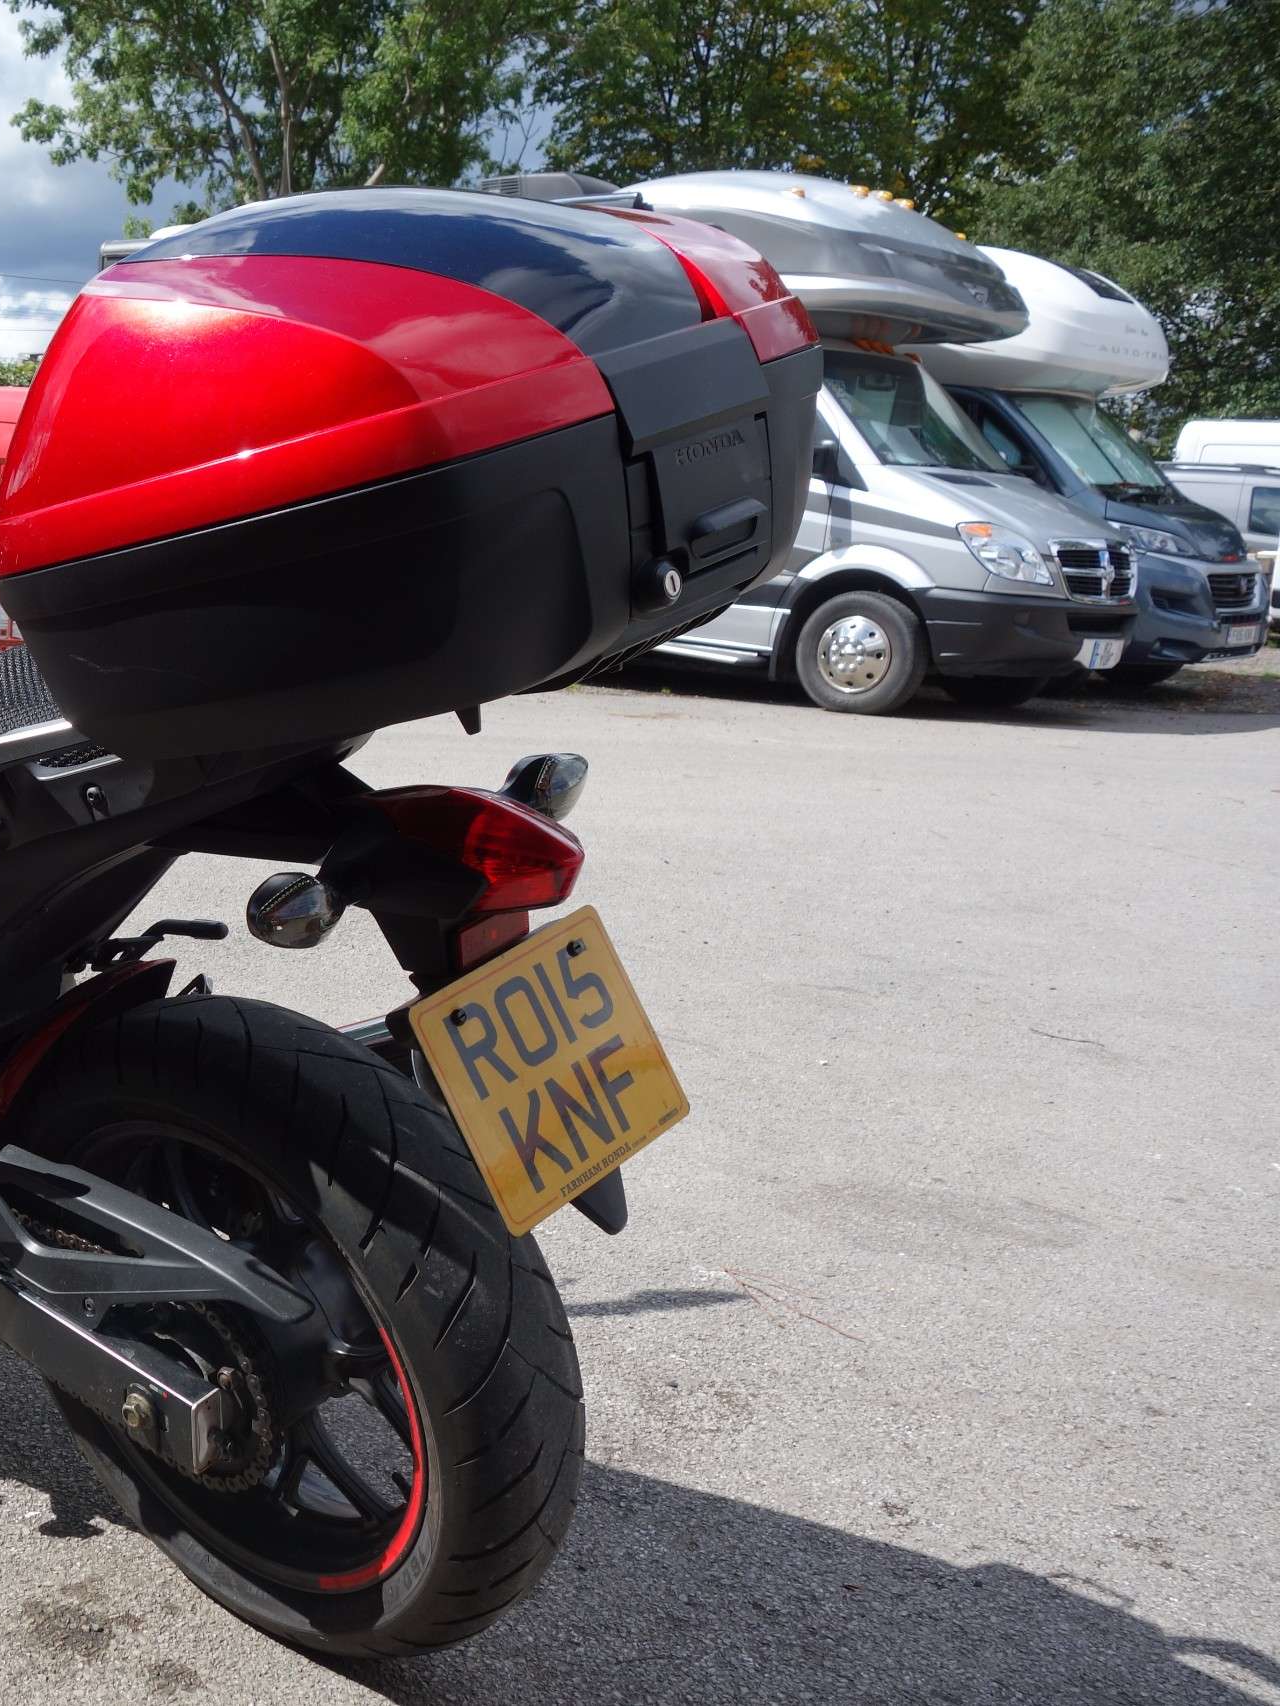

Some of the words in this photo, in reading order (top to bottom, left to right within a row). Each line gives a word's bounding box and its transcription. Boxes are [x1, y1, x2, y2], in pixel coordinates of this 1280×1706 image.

[673, 428, 746, 466] HONDA
[442, 938, 614, 1101] RO15
[498, 1034, 635, 1194] KNF
[560, 1163, 603, 1198] FARNHAM
[601, 1142, 632, 1171] HONDA
